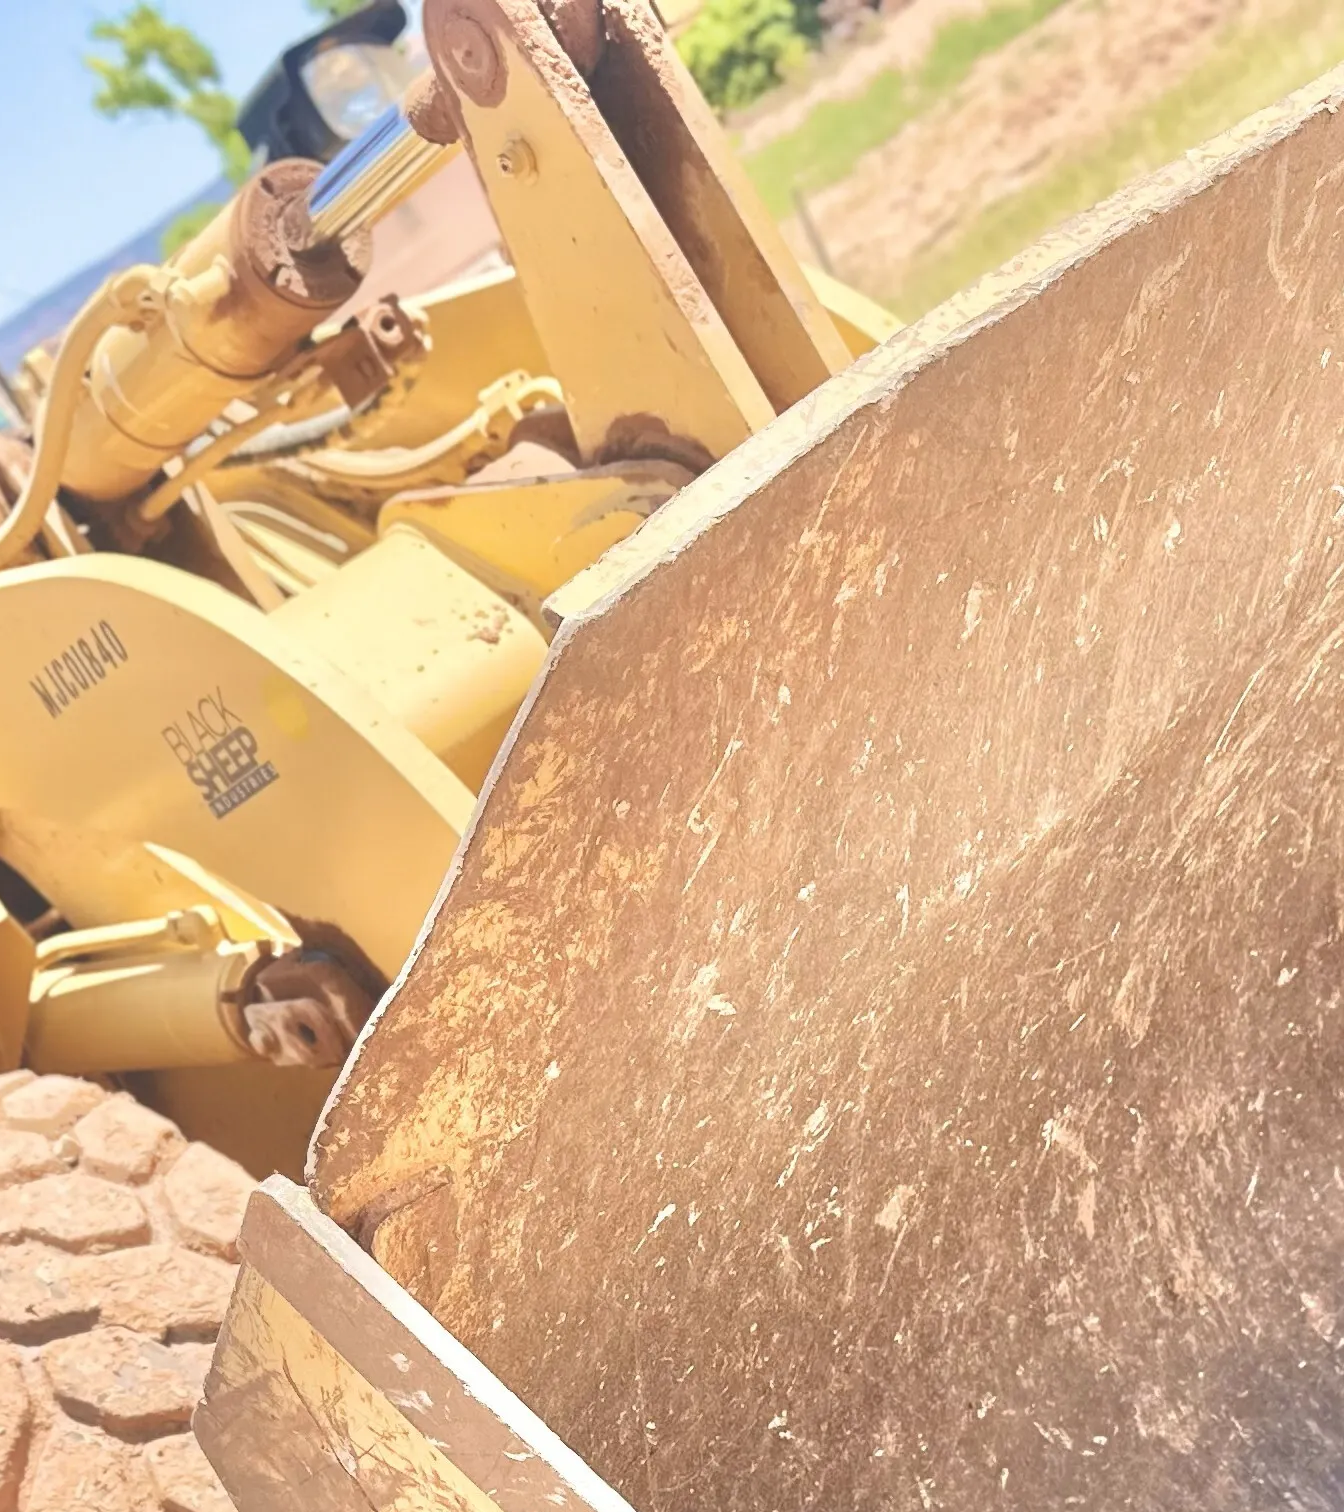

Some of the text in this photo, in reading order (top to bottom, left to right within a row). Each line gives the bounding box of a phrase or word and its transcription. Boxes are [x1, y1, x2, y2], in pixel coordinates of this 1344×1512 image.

[160, 686, 243, 767] BLACK
[186, 725, 259, 802] SHEEP
[208, 762, 279, 819] INDUSTRIES
